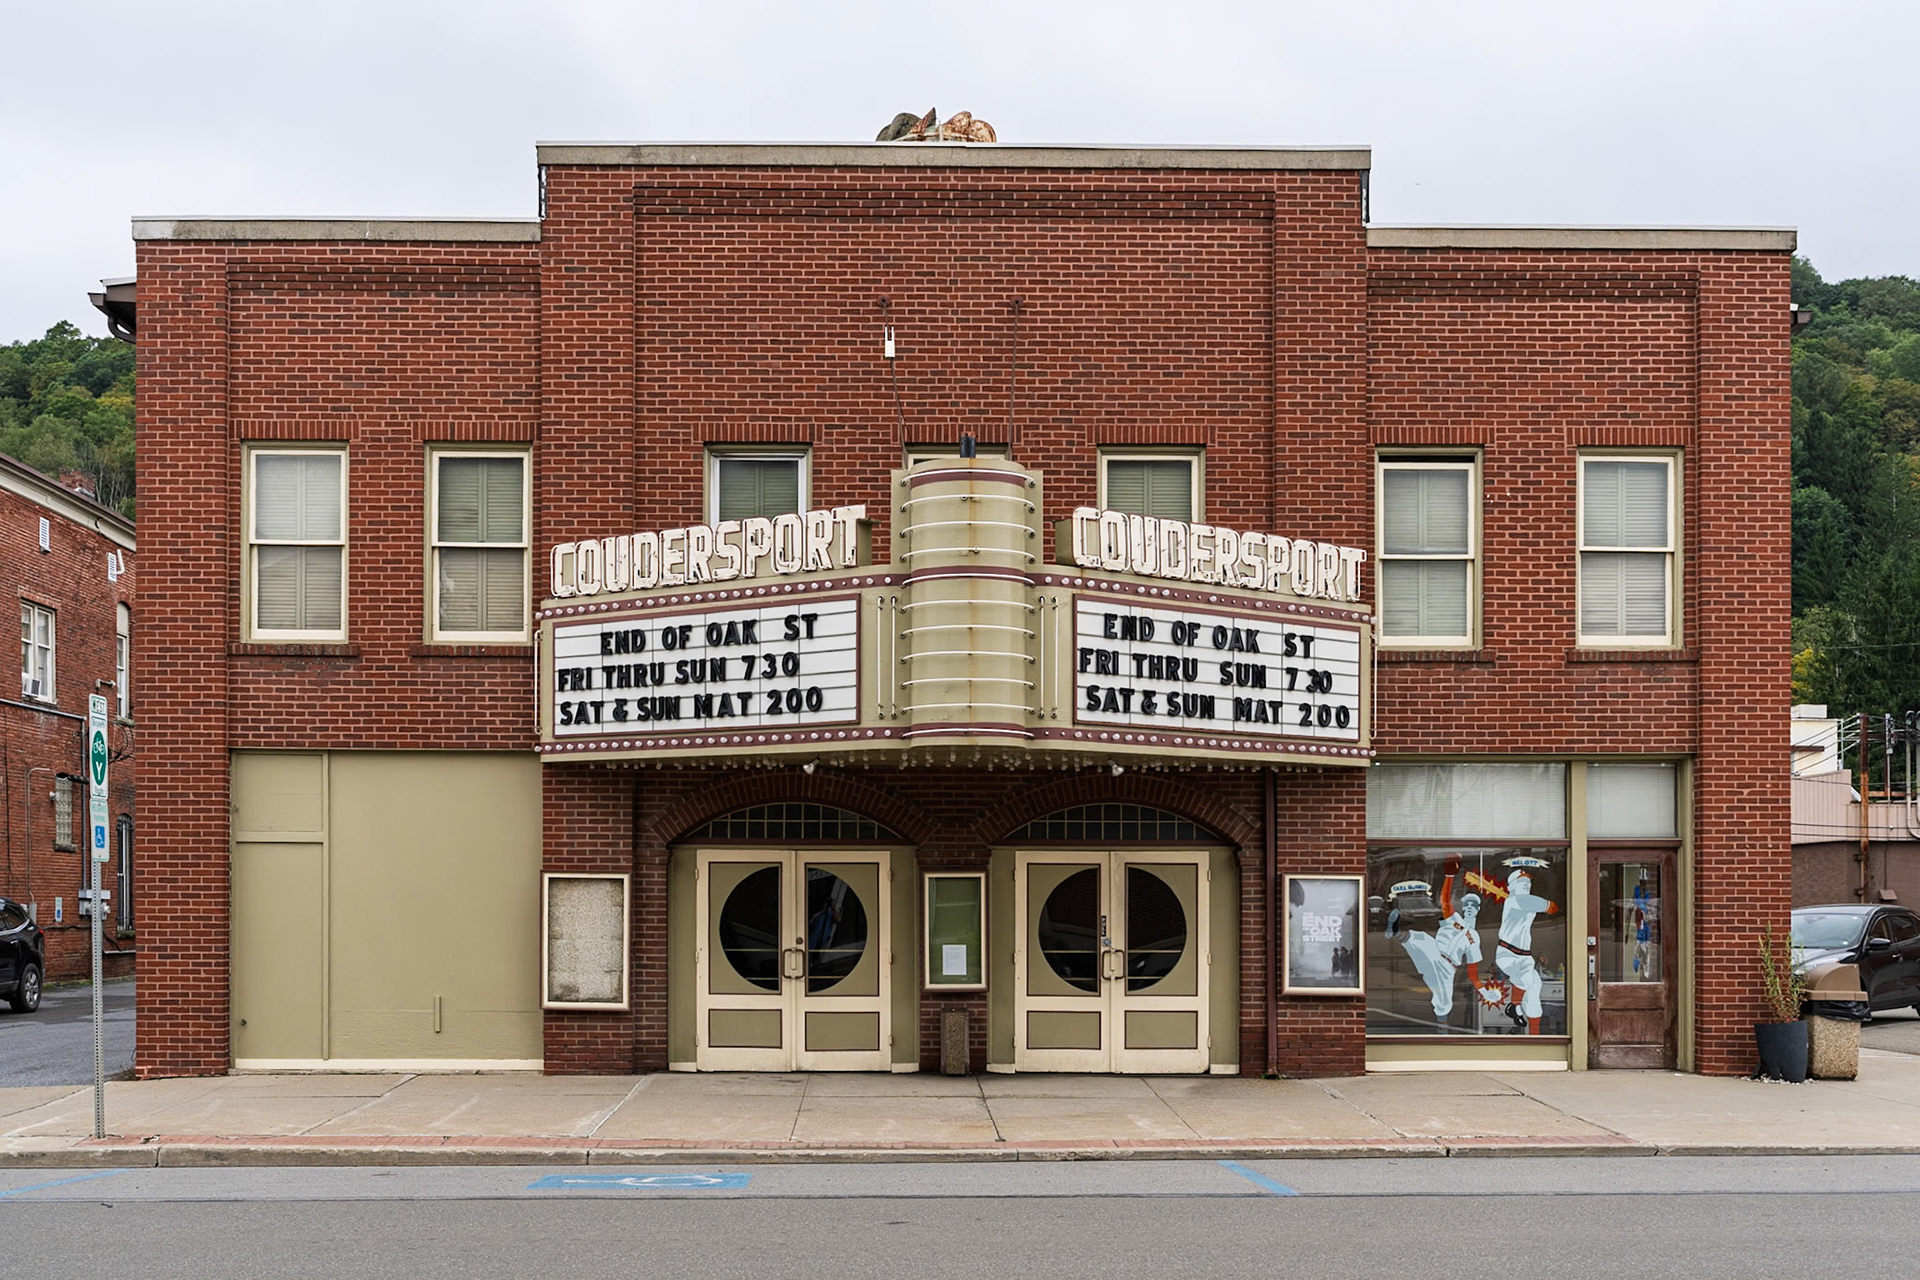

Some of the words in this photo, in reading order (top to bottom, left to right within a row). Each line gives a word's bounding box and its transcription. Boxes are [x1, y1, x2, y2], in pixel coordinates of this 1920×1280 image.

[550, 504, 866, 598] COUDERSPORT
[1072, 506, 1367, 602] COUDERSPORT
[600, 629, 646, 656] END
[661, 624, 692, 650] OF
[706, 618, 758, 647] OAK
[784, 613, 818, 641] ST
[1103, 613, 1155, 642] END
[1172, 620, 1201, 647] OF
[1213, 625, 1260, 654] OAK
[1284, 632, 1315, 659] ST
[557, 666, 593, 692] FRI
[602, 661, 665, 689] THRU
[674, 656, 727, 685] SUN
[1079, 647, 1119, 676] FRI
[1133, 653, 1198, 682] THRU
[1220, 661, 1267, 689] SUN
[559, 700, 605, 726] SAT
[612, 698, 628, 723] &
[637, 695, 681, 721] SUN
[694, 691, 752, 719] MAT
[766, 685, 823, 715] 200
[1086, 684, 1135, 714] SAT
[1141, 689, 1158, 716] &
[1166, 691, 1215, 720] SUN
[1233, 697, 1283, 725] MAT
[1299, 703, 1350, 728] 200
[95, 761, 103, 780] Y
[1302, 915, 1342, 927] END
[1310, 926, 1342, 938] OAK
